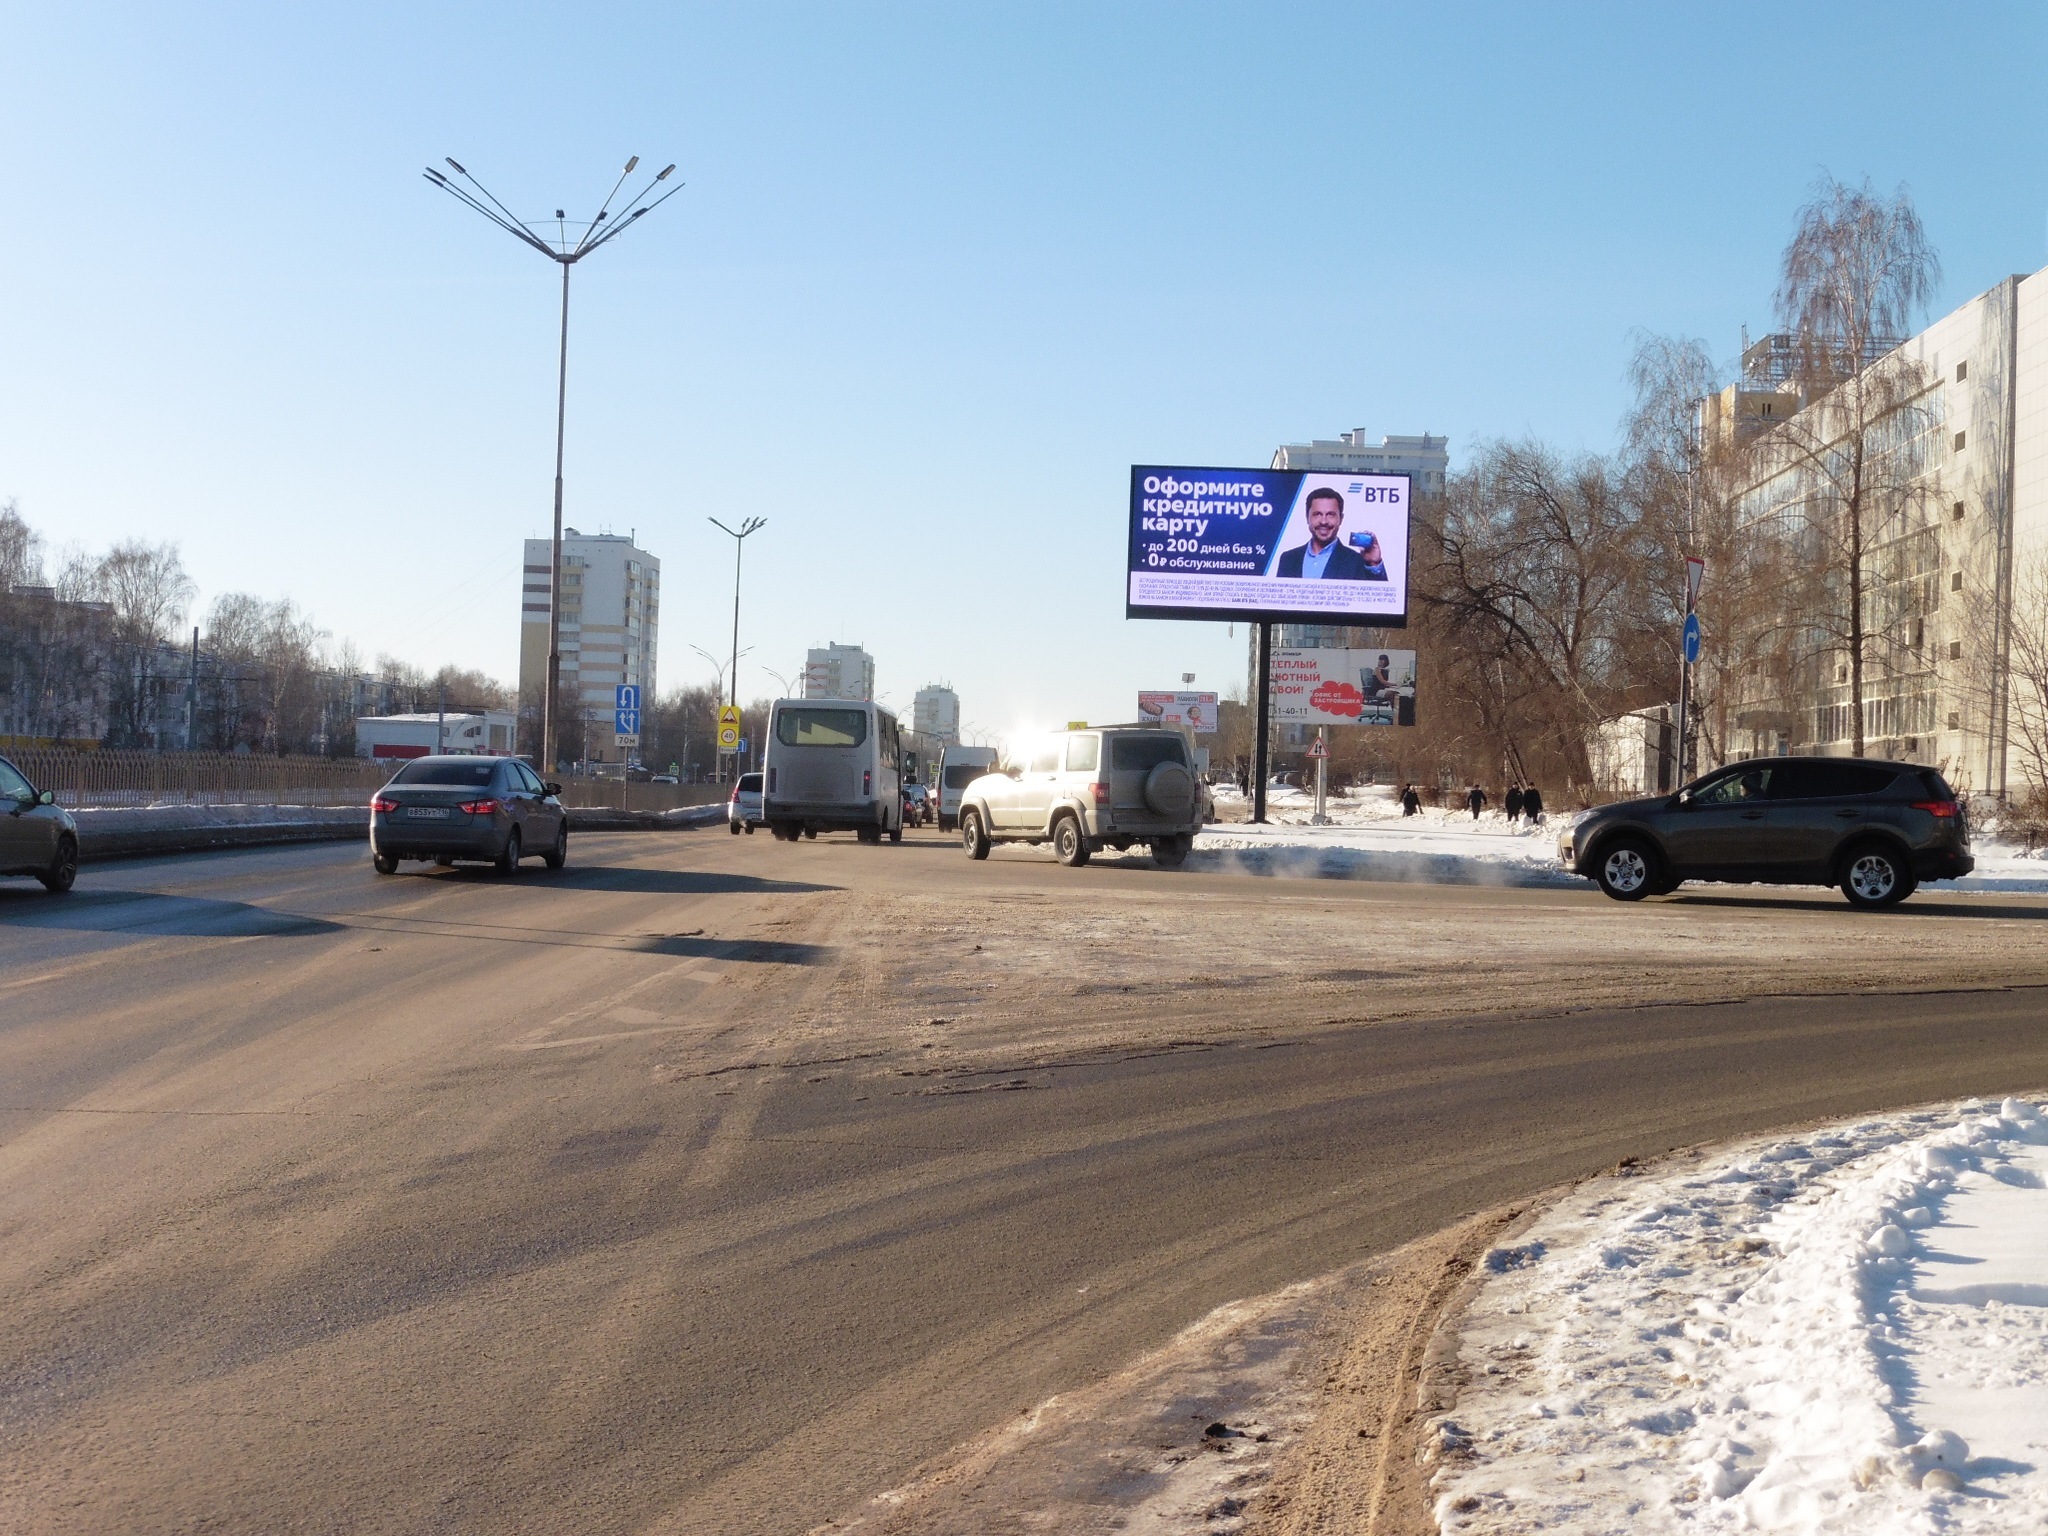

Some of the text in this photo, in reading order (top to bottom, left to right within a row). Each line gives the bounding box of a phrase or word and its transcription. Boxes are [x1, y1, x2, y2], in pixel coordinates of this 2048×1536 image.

[1143, 476, 1265, 499] Оформите
[1365, 487, 1400, 503] ВТБ
[1143, 498, 1273, 520] кредитную
[1142, 517, 1209, 537] карту
[1148, 538, 1266, 555] до 200 дней без %
[1169, 557, 1256, 570] обслуживание
[1271, 659, 1317, 669] ТЕПЛЫЙ
